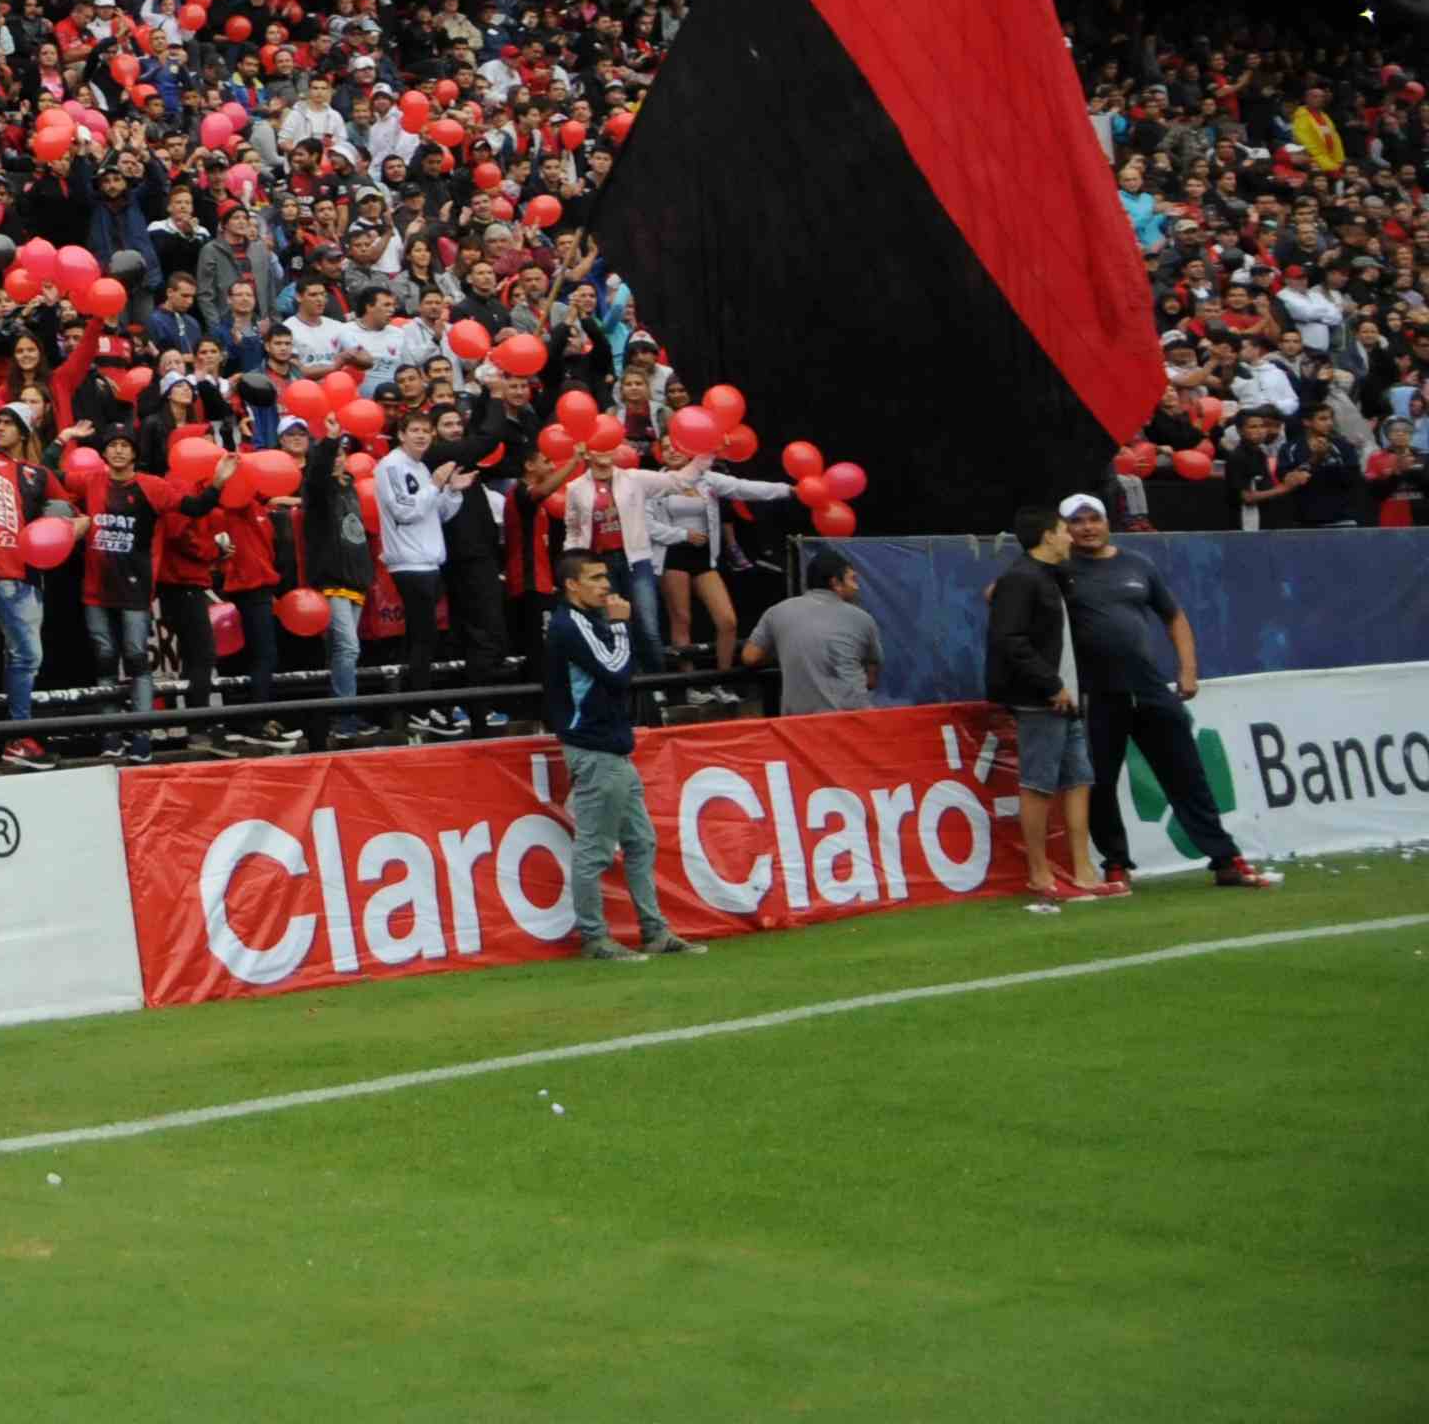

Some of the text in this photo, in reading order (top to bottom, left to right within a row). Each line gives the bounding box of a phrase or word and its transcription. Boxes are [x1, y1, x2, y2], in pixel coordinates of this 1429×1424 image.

[92, 513, 137, 530] OSPAT
[1248, 721, 1429, 809] Banco
[198, 805, 578, 986] Claro
[678, 759, 993, 915] Claro
